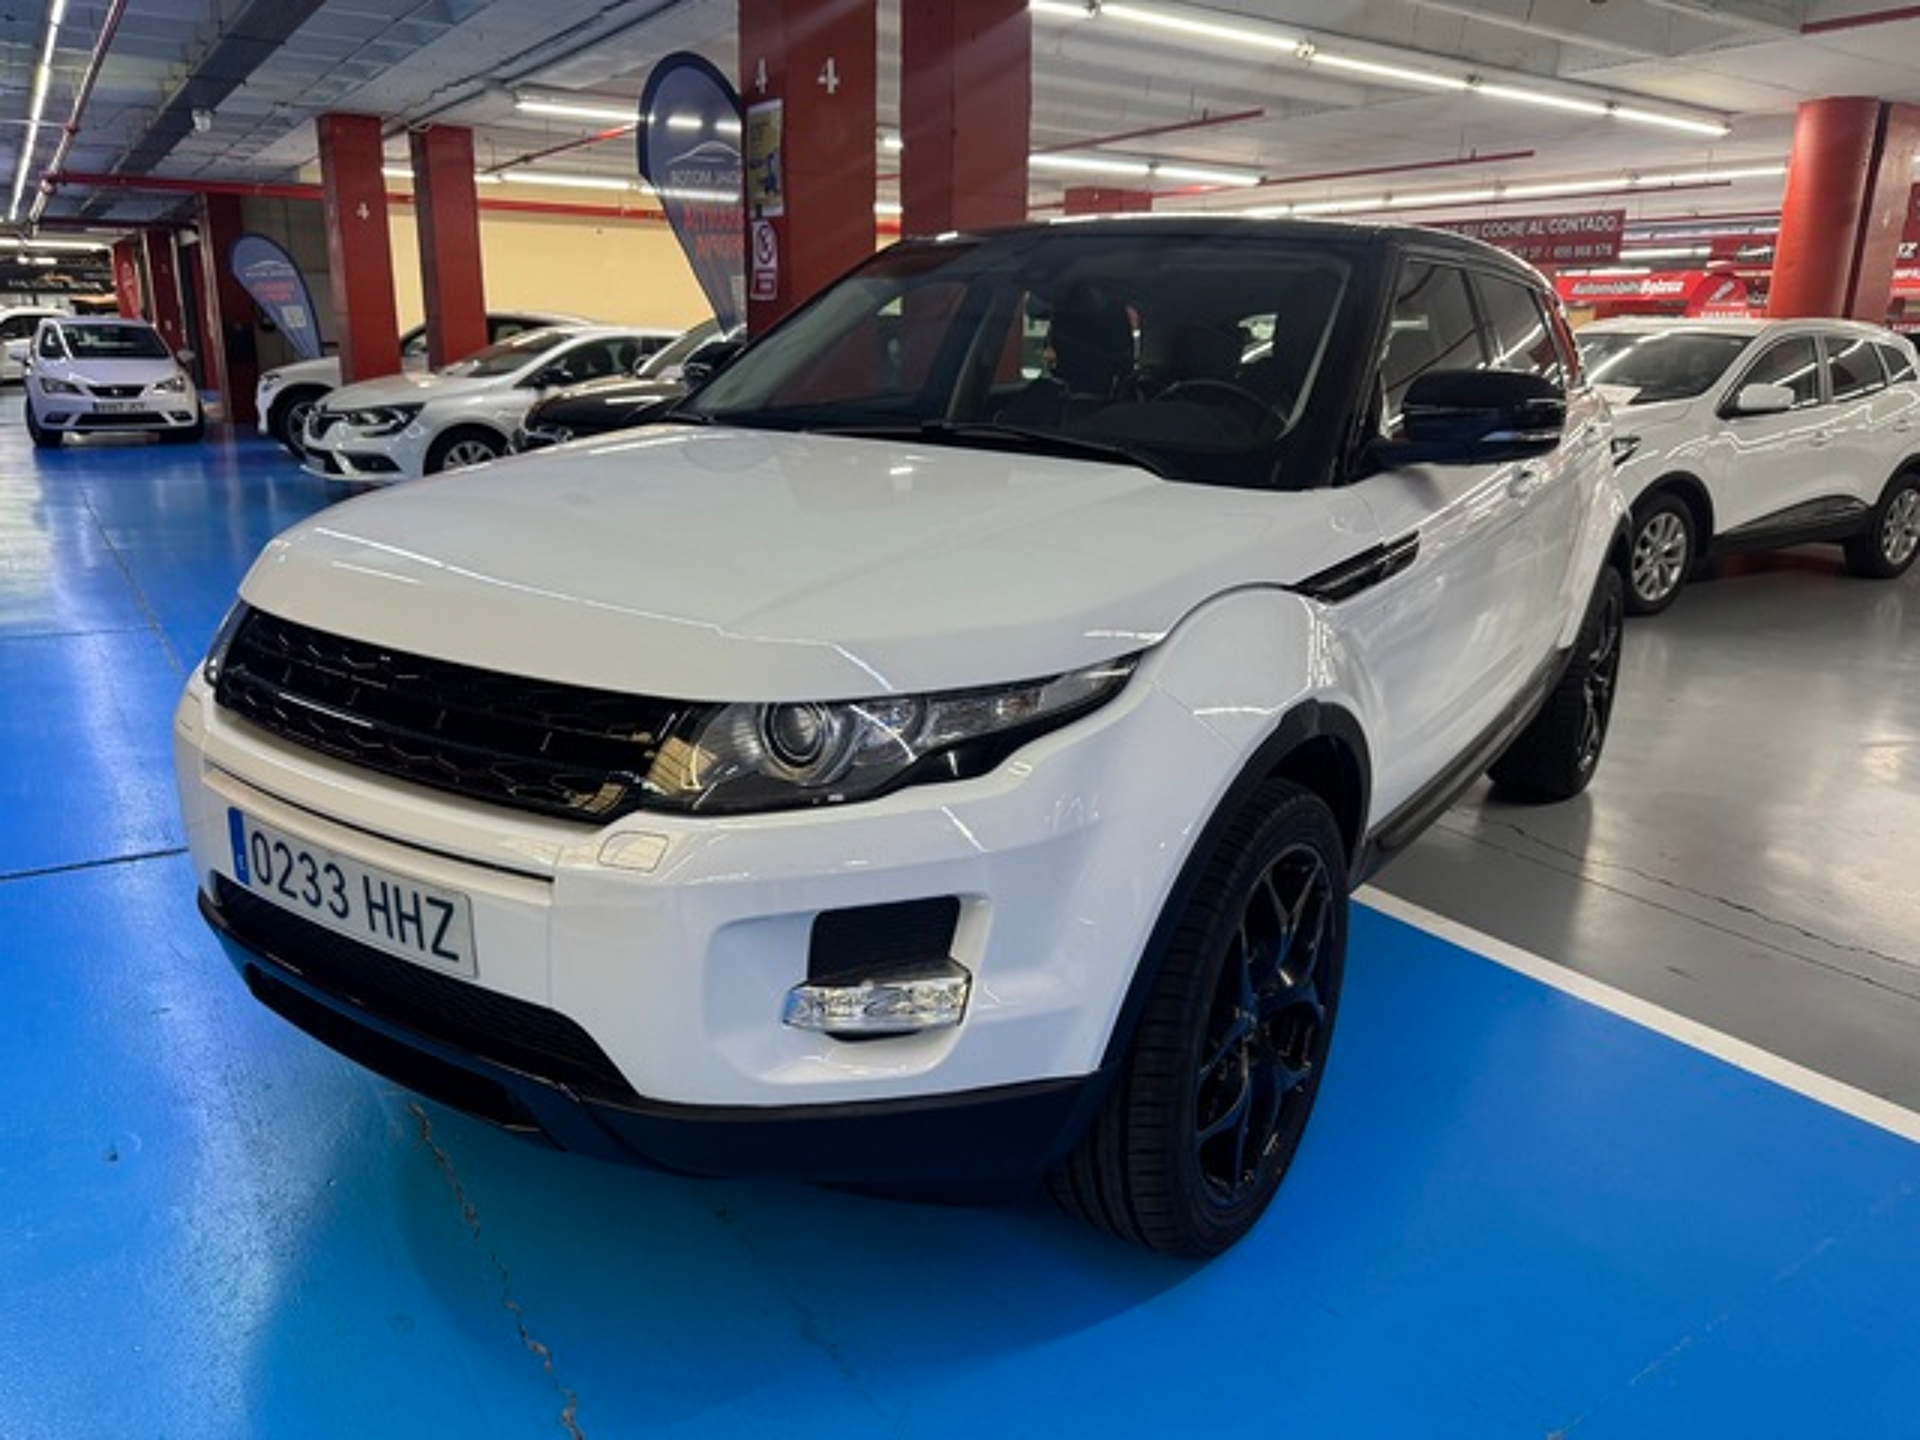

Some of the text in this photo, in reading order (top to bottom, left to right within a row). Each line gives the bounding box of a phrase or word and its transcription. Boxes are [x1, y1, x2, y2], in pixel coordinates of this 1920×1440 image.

[818, 56, 839, 95] 4
[1527, 221, 1546, 235] AL
[251, 830, 350, 920] 0233
[362, 874, 460, 963] HHZ
